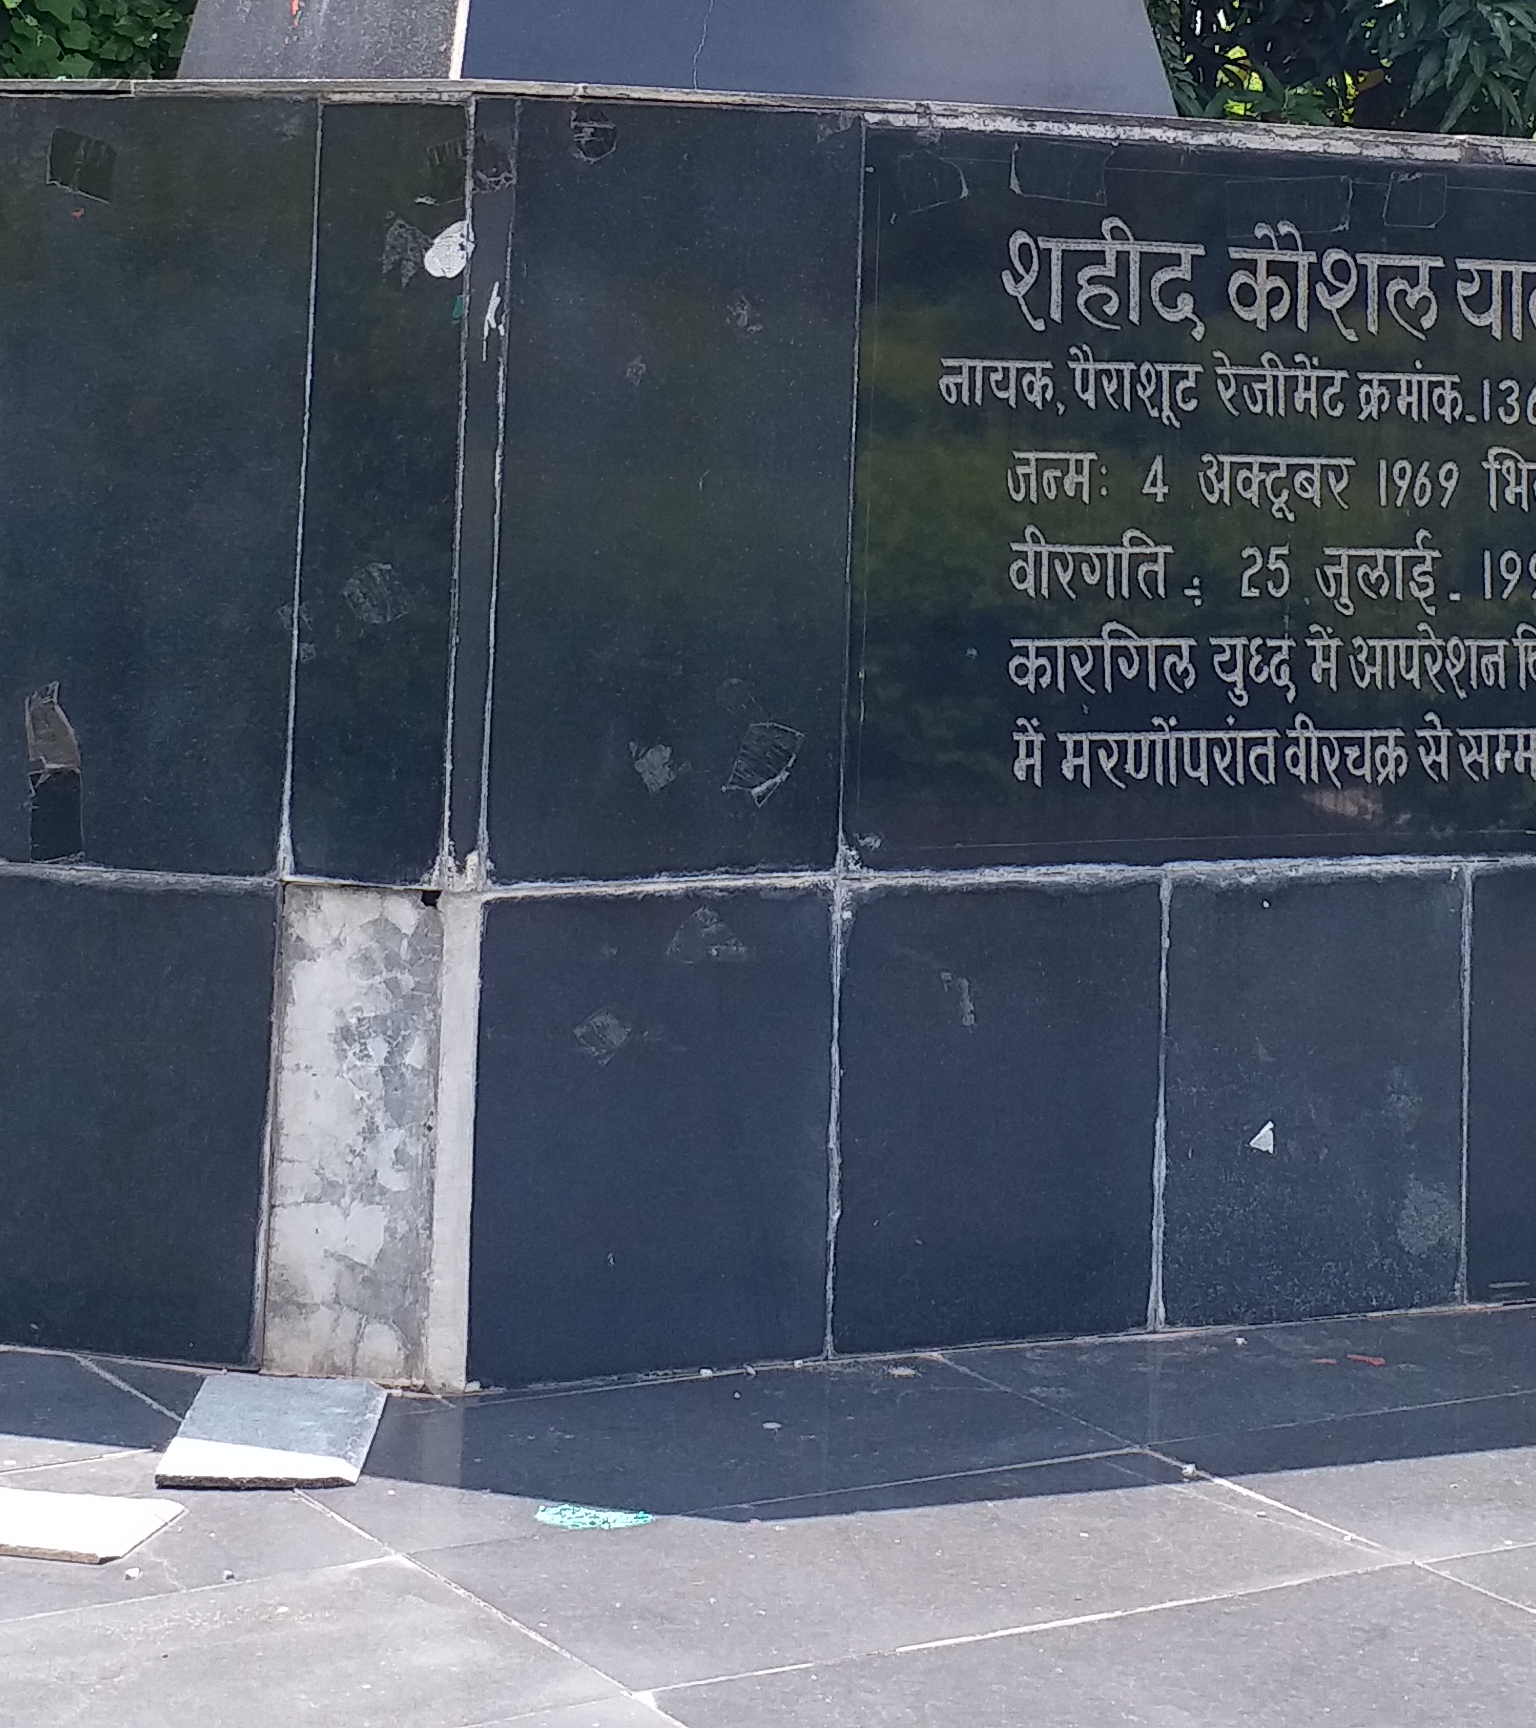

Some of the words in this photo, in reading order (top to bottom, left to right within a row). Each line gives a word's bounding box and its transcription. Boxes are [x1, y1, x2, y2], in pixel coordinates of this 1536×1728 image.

[1001, 216, 1207, 342] शहीद
[1227, 220, 1446, 342] कौशल
[1066, 343, 1204, 428] पैराशूट
[1213, 349, 1350, 420] रेजीमेंट
[1141, 454, 1169, 503] 4
[1198, 453, 1357, 522] अक्टूबर
[1378, 459, 1460, 508] 1969
[1240, 542, 1291, 598] 25
[1008, 620, 1198, 694] कारगिल
[1305, 623, 1344, 692] में
[1348, 622, 1510, 699] आपरेशन
[1012, 716, 1047, 788] में
[1284, 711, 1409, 790] वीरचक्र
[1415, 710, 1453, 782] से
